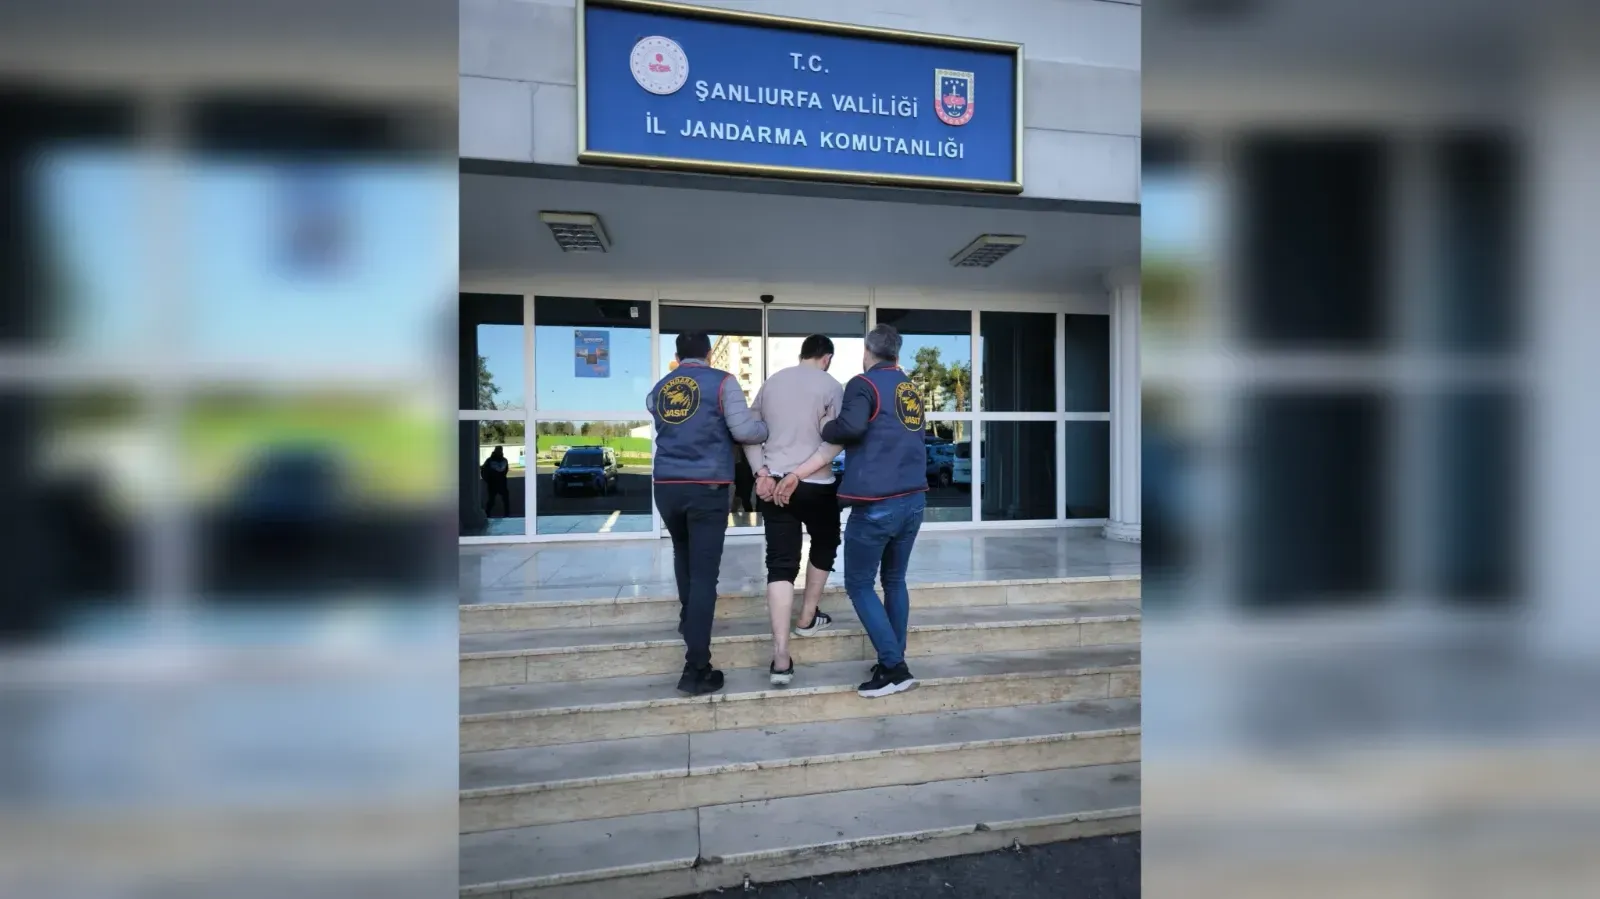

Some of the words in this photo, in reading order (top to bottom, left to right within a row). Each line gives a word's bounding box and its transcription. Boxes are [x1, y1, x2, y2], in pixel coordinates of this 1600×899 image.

[790, 52, 829, 74] T.C.
[695, 80, 823, 111] ŞANLIURFA
[831, 92, 918, 118] VALİLİĞİ
[646, 112, 666, 135] İL
[680, 119, 807, 147] JANDARMA
[821, 131, 964, 159] KOMUTANLIĞI
[664, 408, 689, 417] JASAT
